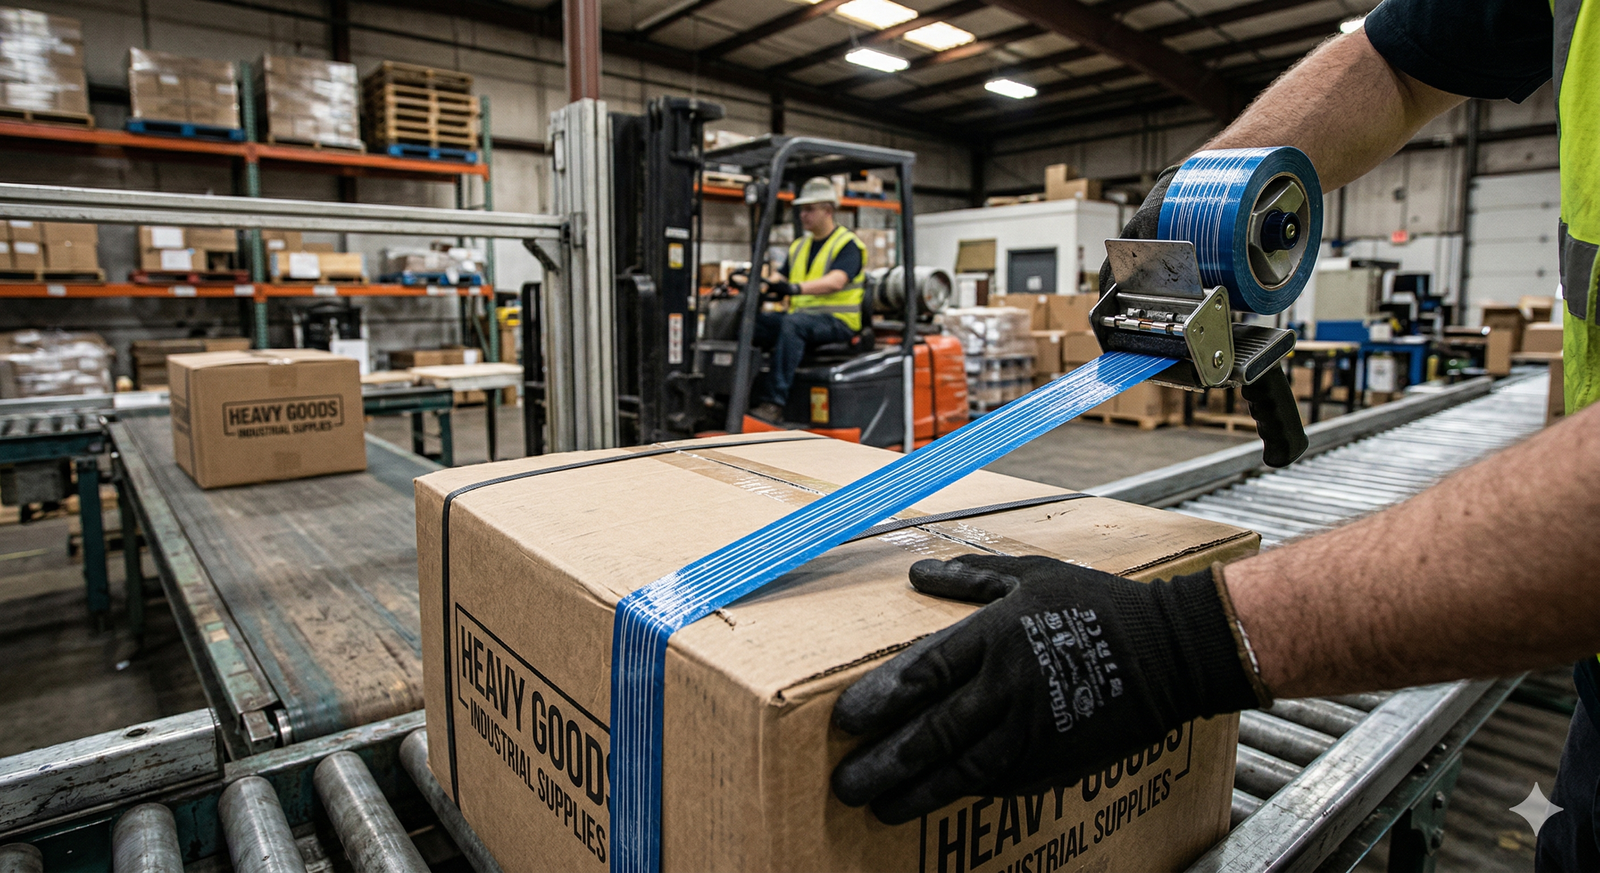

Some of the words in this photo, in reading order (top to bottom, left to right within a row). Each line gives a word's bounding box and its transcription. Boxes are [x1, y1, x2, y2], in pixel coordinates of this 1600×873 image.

[228, 404, 283, 427] HEAVY
[286, 400, 339, 422] GOODS
[237, 425, 291, 440] INDUSTRIAL
[292, 420, 334, 435] SUPPLIES
[461, 625, 525, 733] HEAVY
[531, 691, 611, 814] GOOD
[470, 697, 535, 793] INDUSTRIAL
[537, 767, 607, 865] SUPPLIES
[1093, 768, 1172, 845] SUPPLIES
